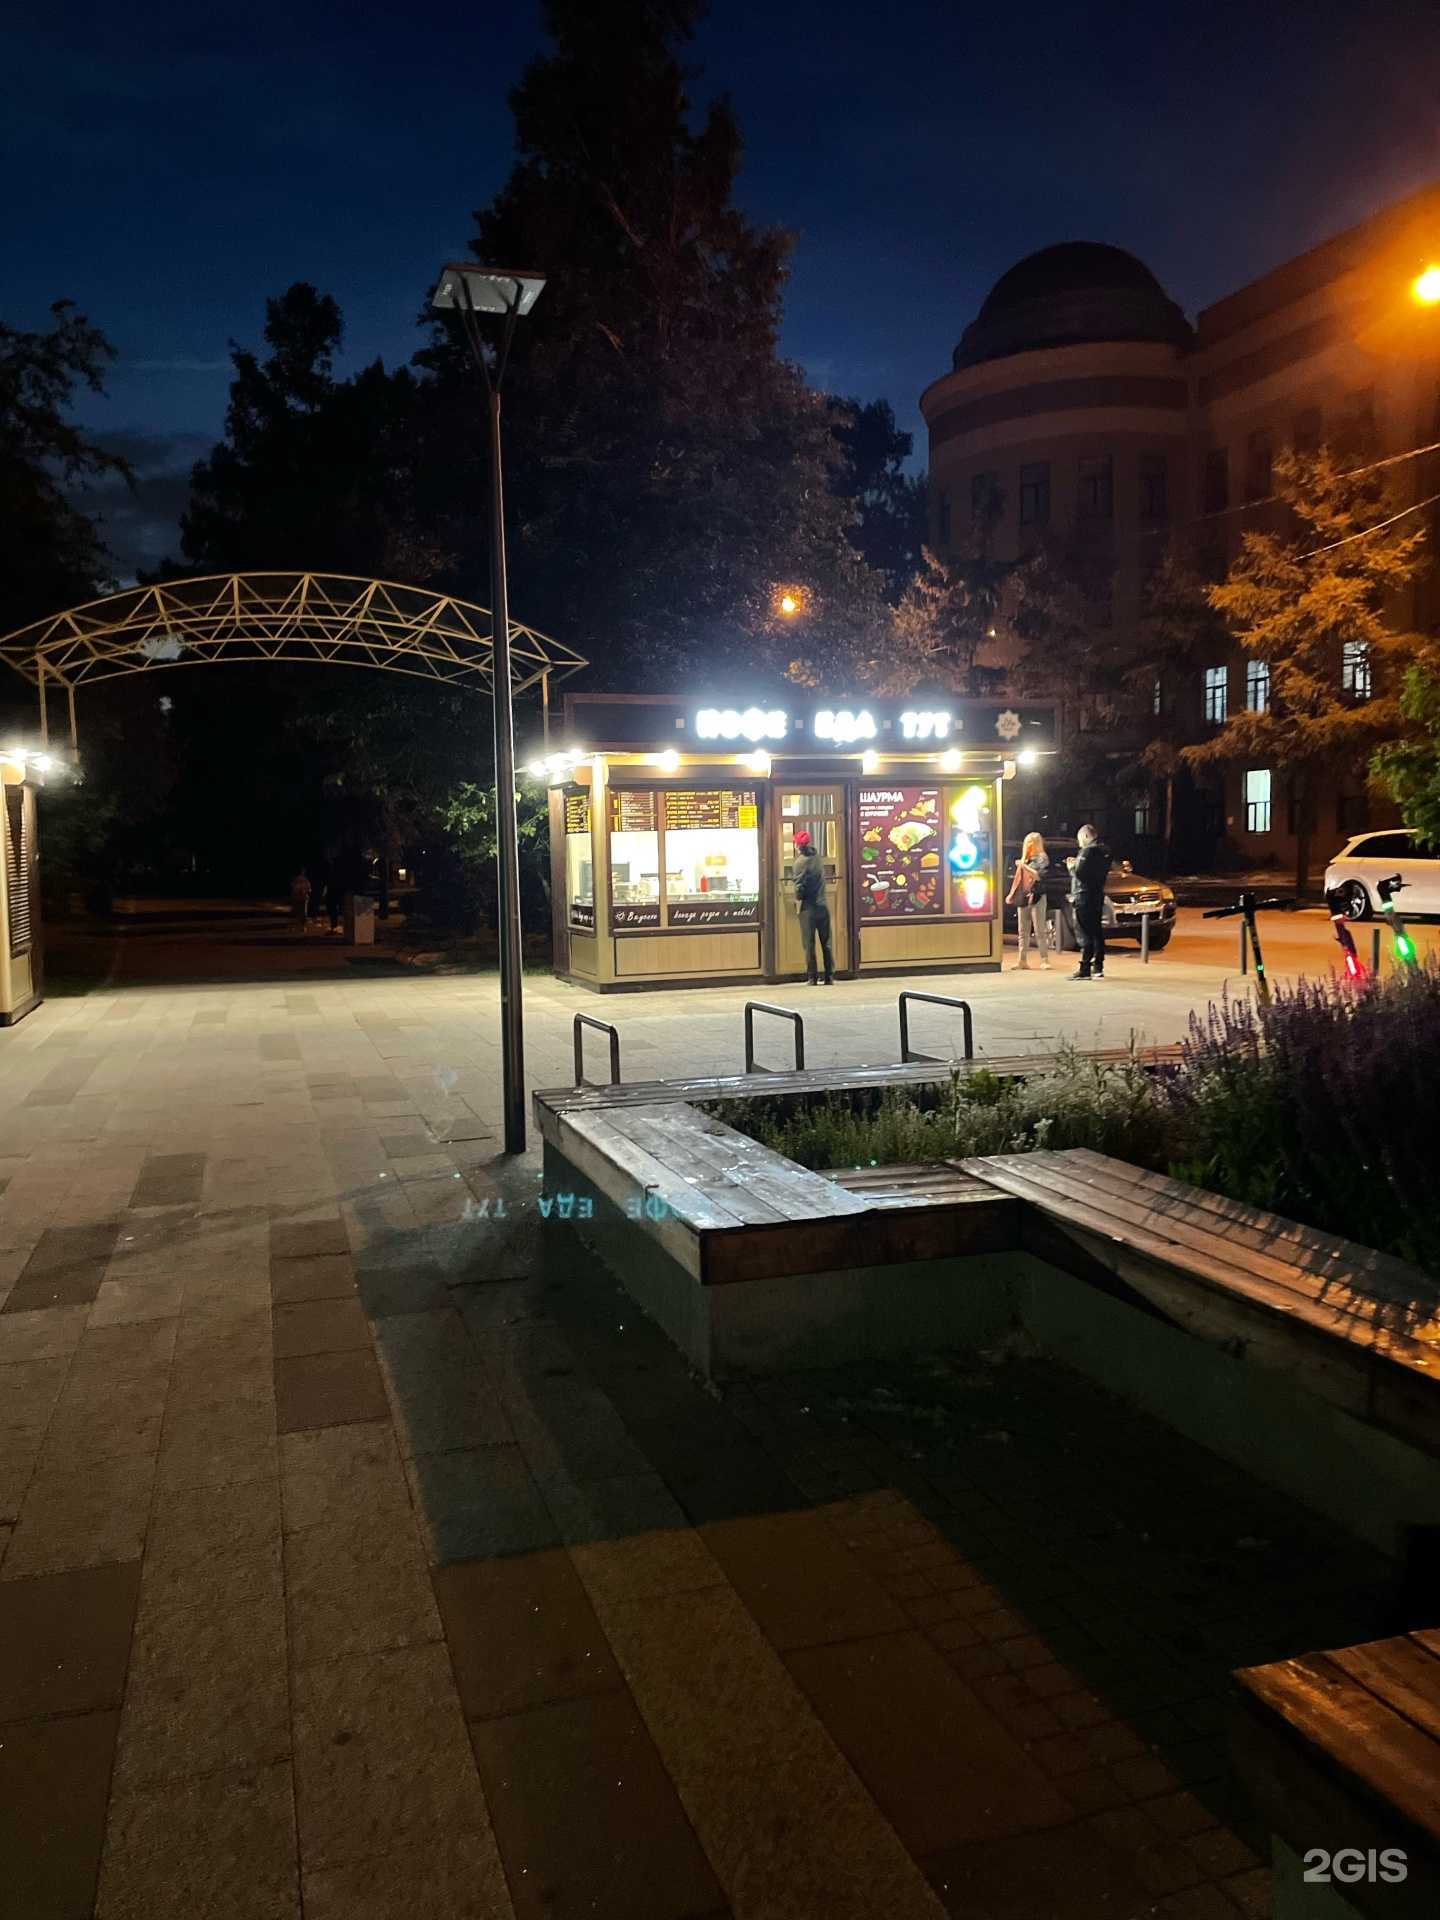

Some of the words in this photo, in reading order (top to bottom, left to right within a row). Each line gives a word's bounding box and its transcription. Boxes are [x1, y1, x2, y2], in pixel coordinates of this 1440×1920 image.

[815, 711, 876, 741] ЕДА
[901, 712, 951, 737] ТУТ
[860, 792, 904, 802] ШАУРМА
